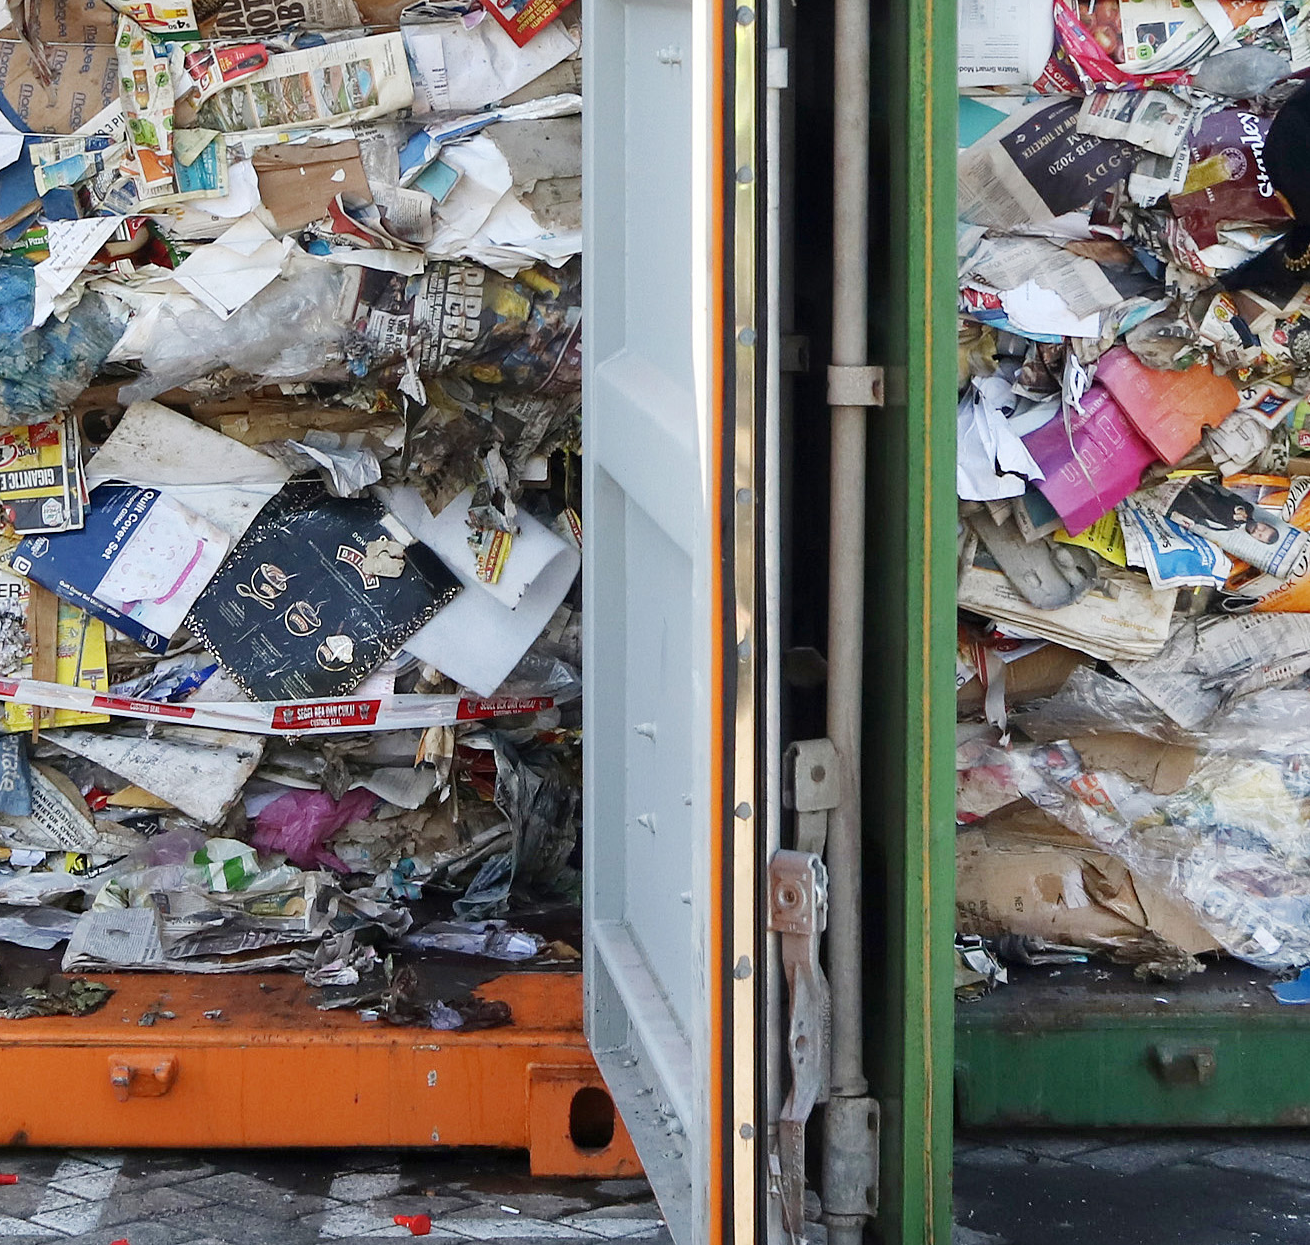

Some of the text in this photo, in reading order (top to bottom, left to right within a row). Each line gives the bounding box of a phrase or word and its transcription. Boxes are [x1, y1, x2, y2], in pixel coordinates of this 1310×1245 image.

[979, 66, 996, 74] Smart
[1053, 71, 1069, 87] OFF
[104, 124, 114, 133] 3
[1021, 123, 1063, 160] AT TICKETEK
[1048, 136, 1101, 176] FEB 2020
[1237, 112, 1274, 198] Stanley
[1172, 163, 1183, 183] court
[7, 467, 55, 489] GIGANTIC
[101, 491, 156, 561] Quilt Cover Set
[1265, 580, 1297, 603] PACK
[296, 703, 355, 719] SEGEL BEA DAN CUKAI
[34, 789, 55, 809] DANIEL
